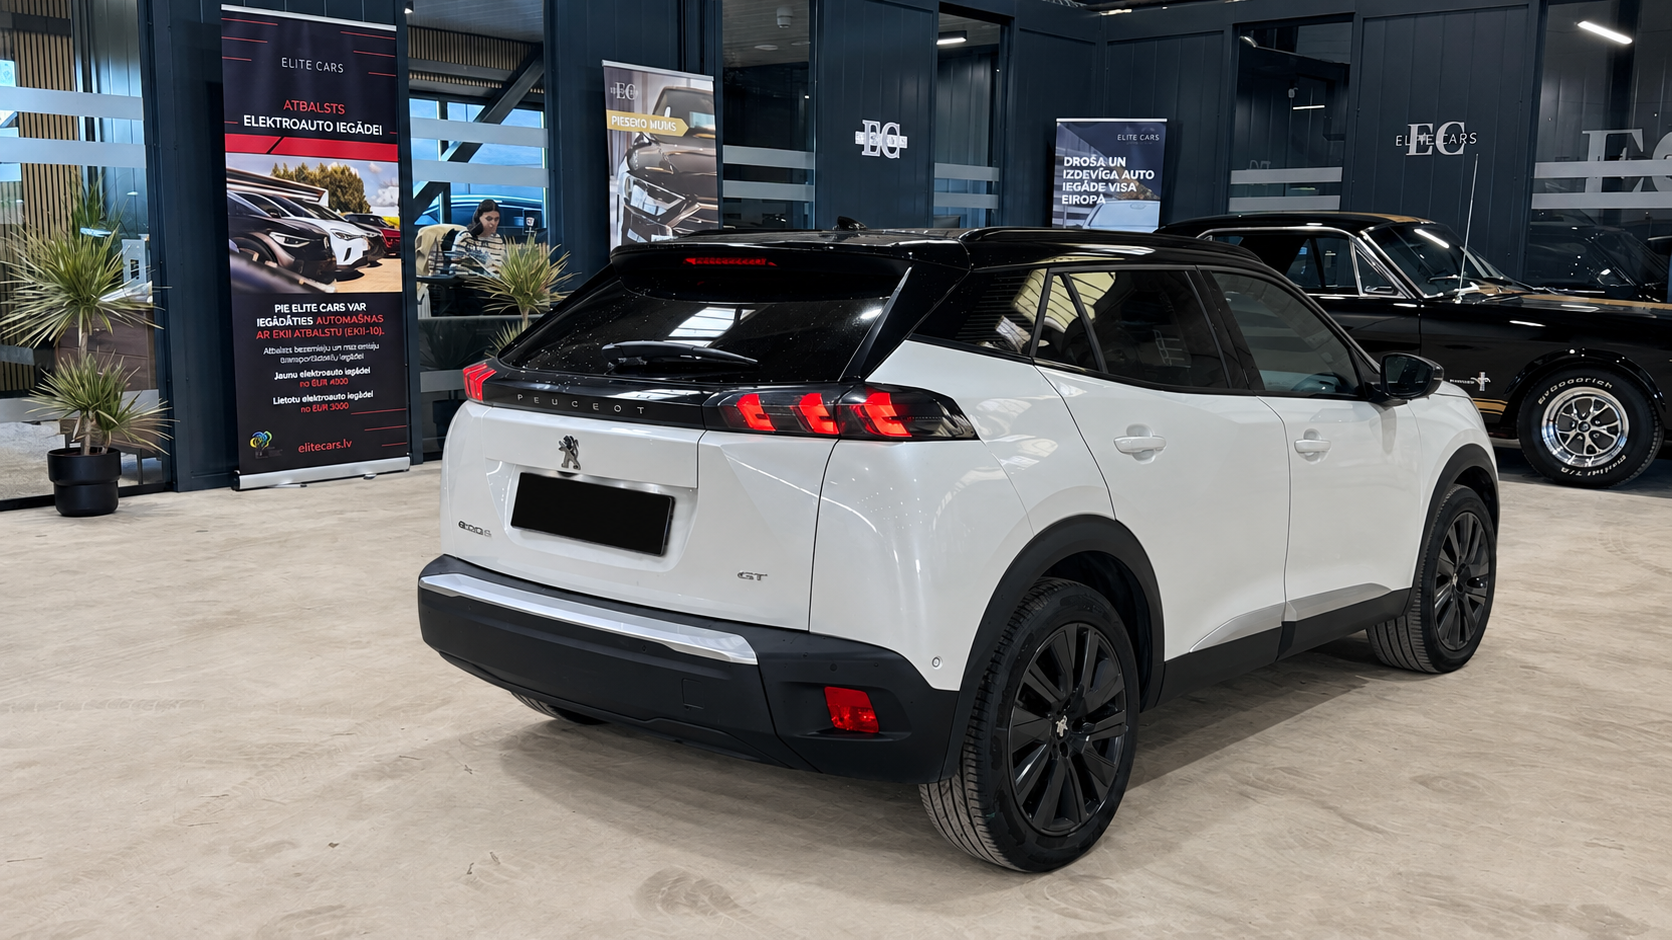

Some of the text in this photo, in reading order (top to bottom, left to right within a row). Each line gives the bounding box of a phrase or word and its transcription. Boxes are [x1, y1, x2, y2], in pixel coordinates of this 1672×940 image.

[281, 57, 344, 73] ELITE CARS
[283, 100, 345, 114] ATBALSTS
[243, 114, 382, 136] ELEKTROAUTO IEGĀDEI
[1063, 154, 1126, 167] DROŠA UN
[1121, 170, 1155, 180] AUTO
[1108, 182, 1137, 192] VISA
[275, 302, 366, 313] PIE ELITE CARS VAR
[256, 331, 270, 339] AR
[294, 328, 342, 338] ATBALSTU
[298, 439, 352, 453] elitecars.lv
[737, 571, 768, 581] GT
